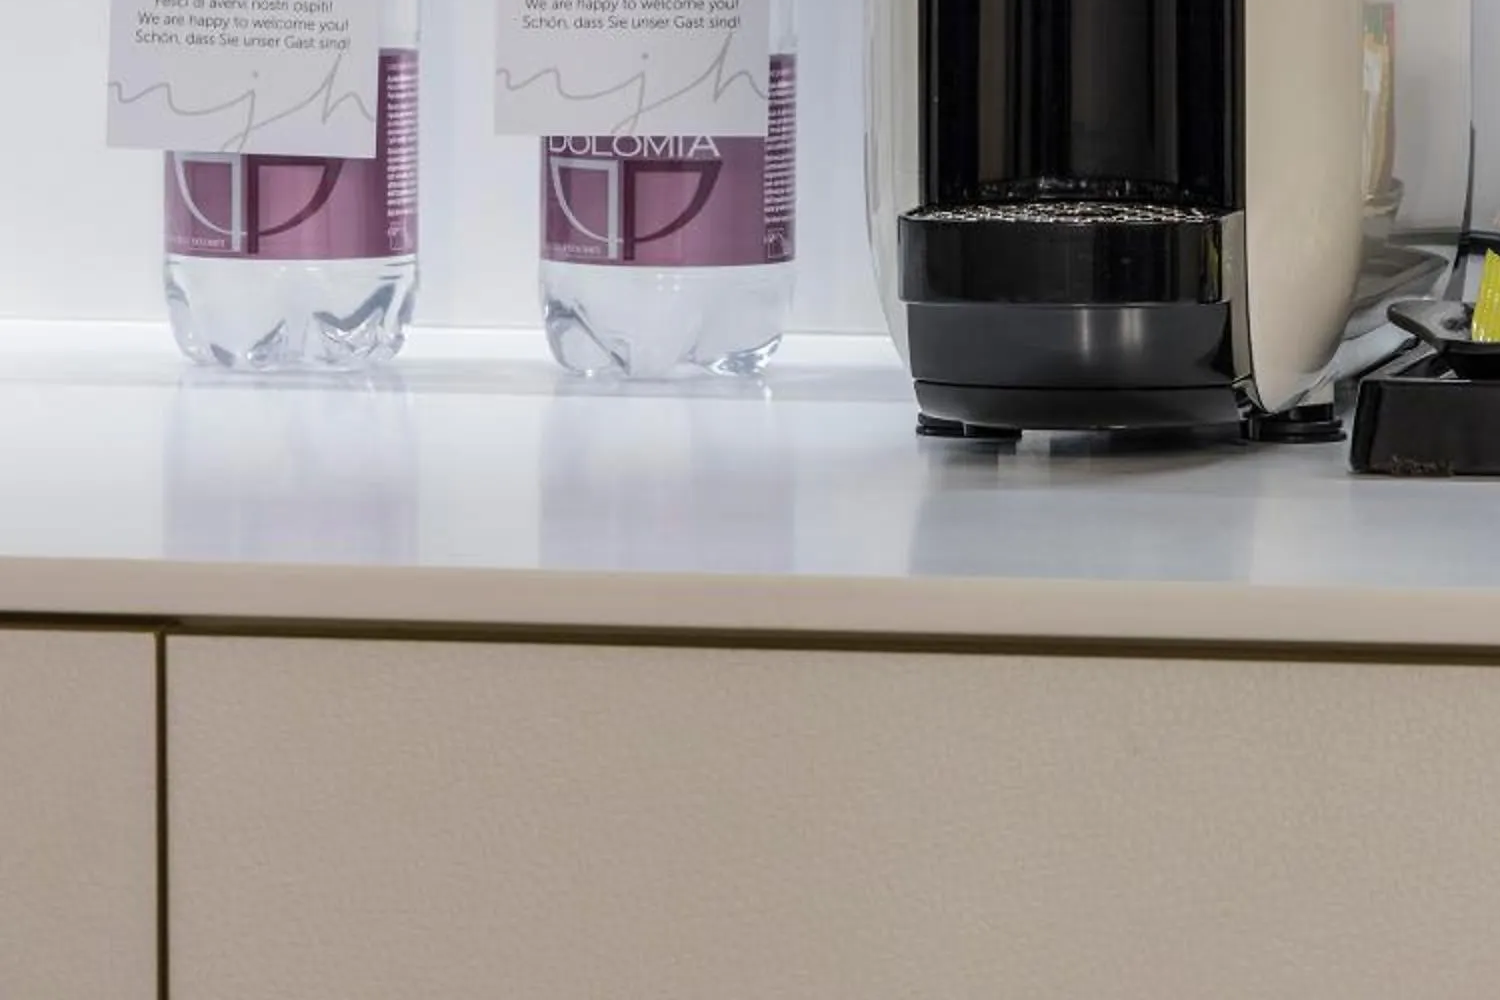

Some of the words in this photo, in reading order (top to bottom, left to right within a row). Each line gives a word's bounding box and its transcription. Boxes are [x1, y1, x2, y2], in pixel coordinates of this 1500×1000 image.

[552, 0, 573, 10] are
[138, 11, 158, 27] We
[163, 16, 185, 27] are
[189, 14, 230, 30] happy
[234, 16, 249, 28] to
[252, 17, 315, 31] welcome
[319, 18, 350, 33] you!
[574, 16, 603, 29] dass
[608, 16, 628, 29] Sie
[631, 18, 669, 29] unser
[673, 16, 705, 29] Gast
[709, 15, 740, 29] sind!
[185, 33, 216, 46] dass
[219, 33, 240, 46] Sie
[243, 36, 280, 48] unser
[284, 36, 315, 49] Gast
[550, 135, 721, 158] DOLOMIA
